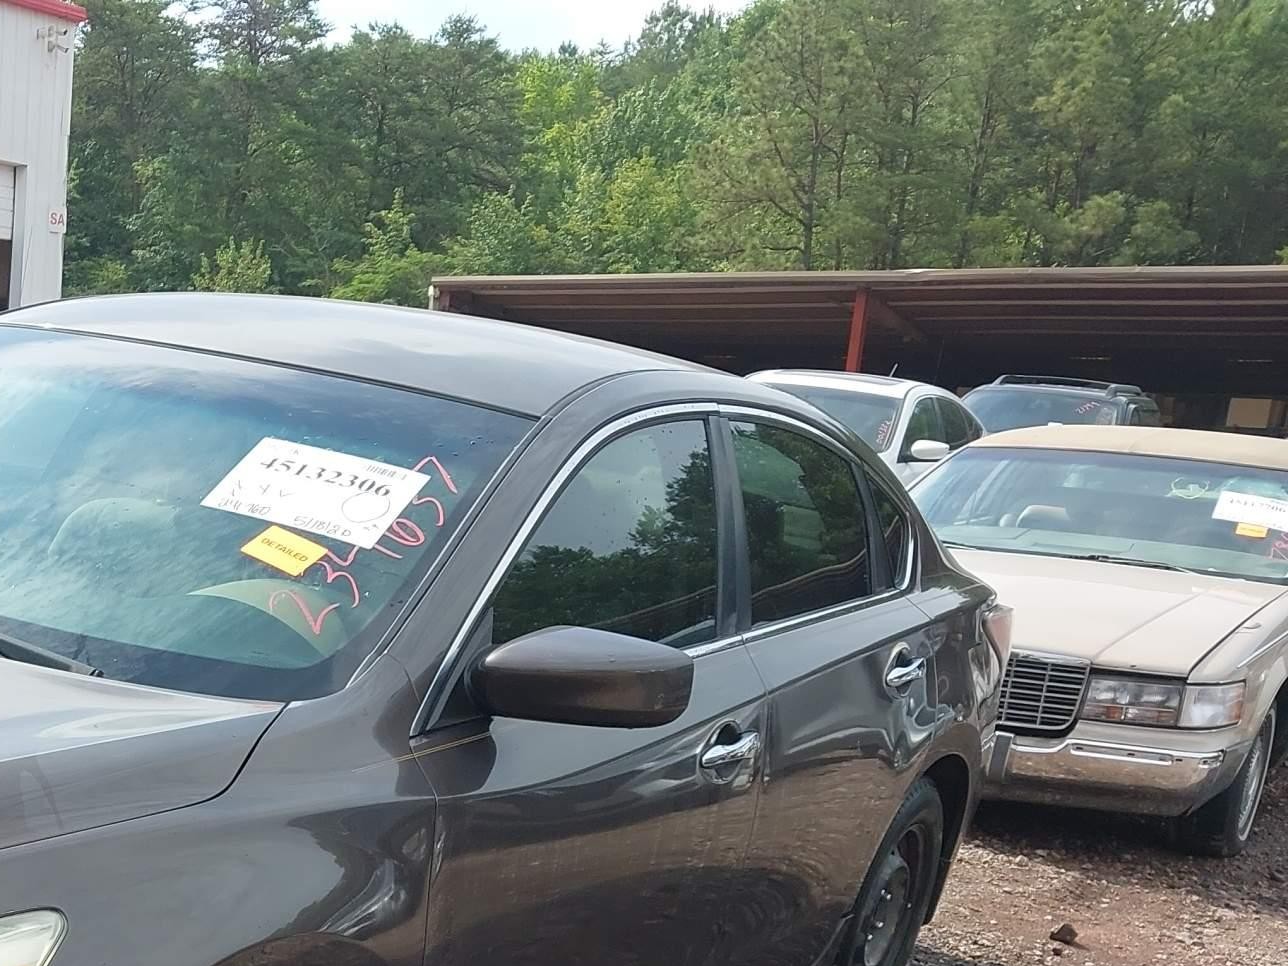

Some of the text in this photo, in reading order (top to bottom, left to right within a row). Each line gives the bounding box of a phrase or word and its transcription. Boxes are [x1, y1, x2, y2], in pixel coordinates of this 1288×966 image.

[50, 212, 65, 226] SA
[259, 456, 393, 498] 45132306
[261, 537, 309, 562] DETAILED
